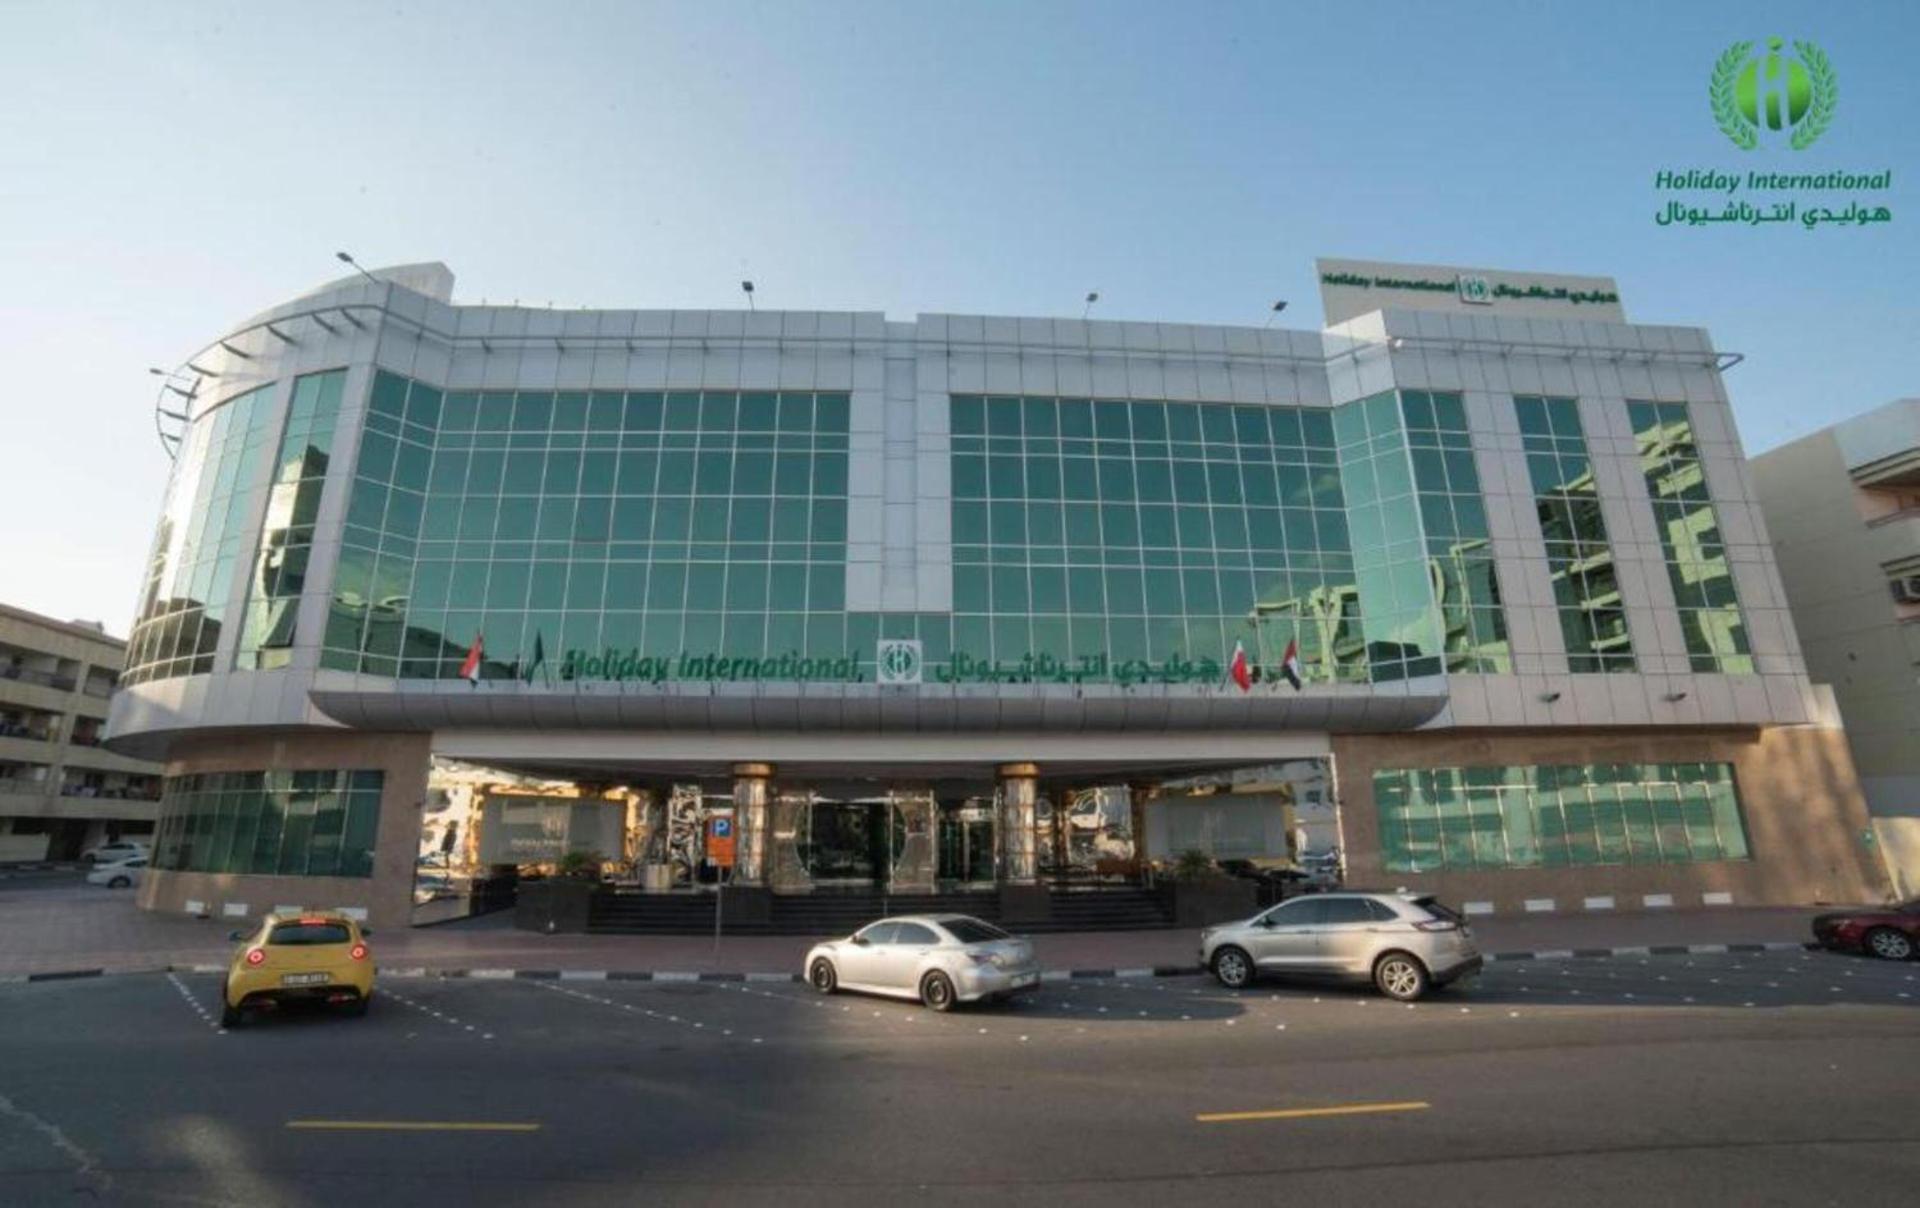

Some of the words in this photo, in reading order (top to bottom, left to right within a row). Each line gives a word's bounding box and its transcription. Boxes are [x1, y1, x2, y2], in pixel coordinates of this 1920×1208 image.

[562, 649, 668, 684] Holiday
[678, 649, 861, 682] International
[715, 819, 729, 836] P
